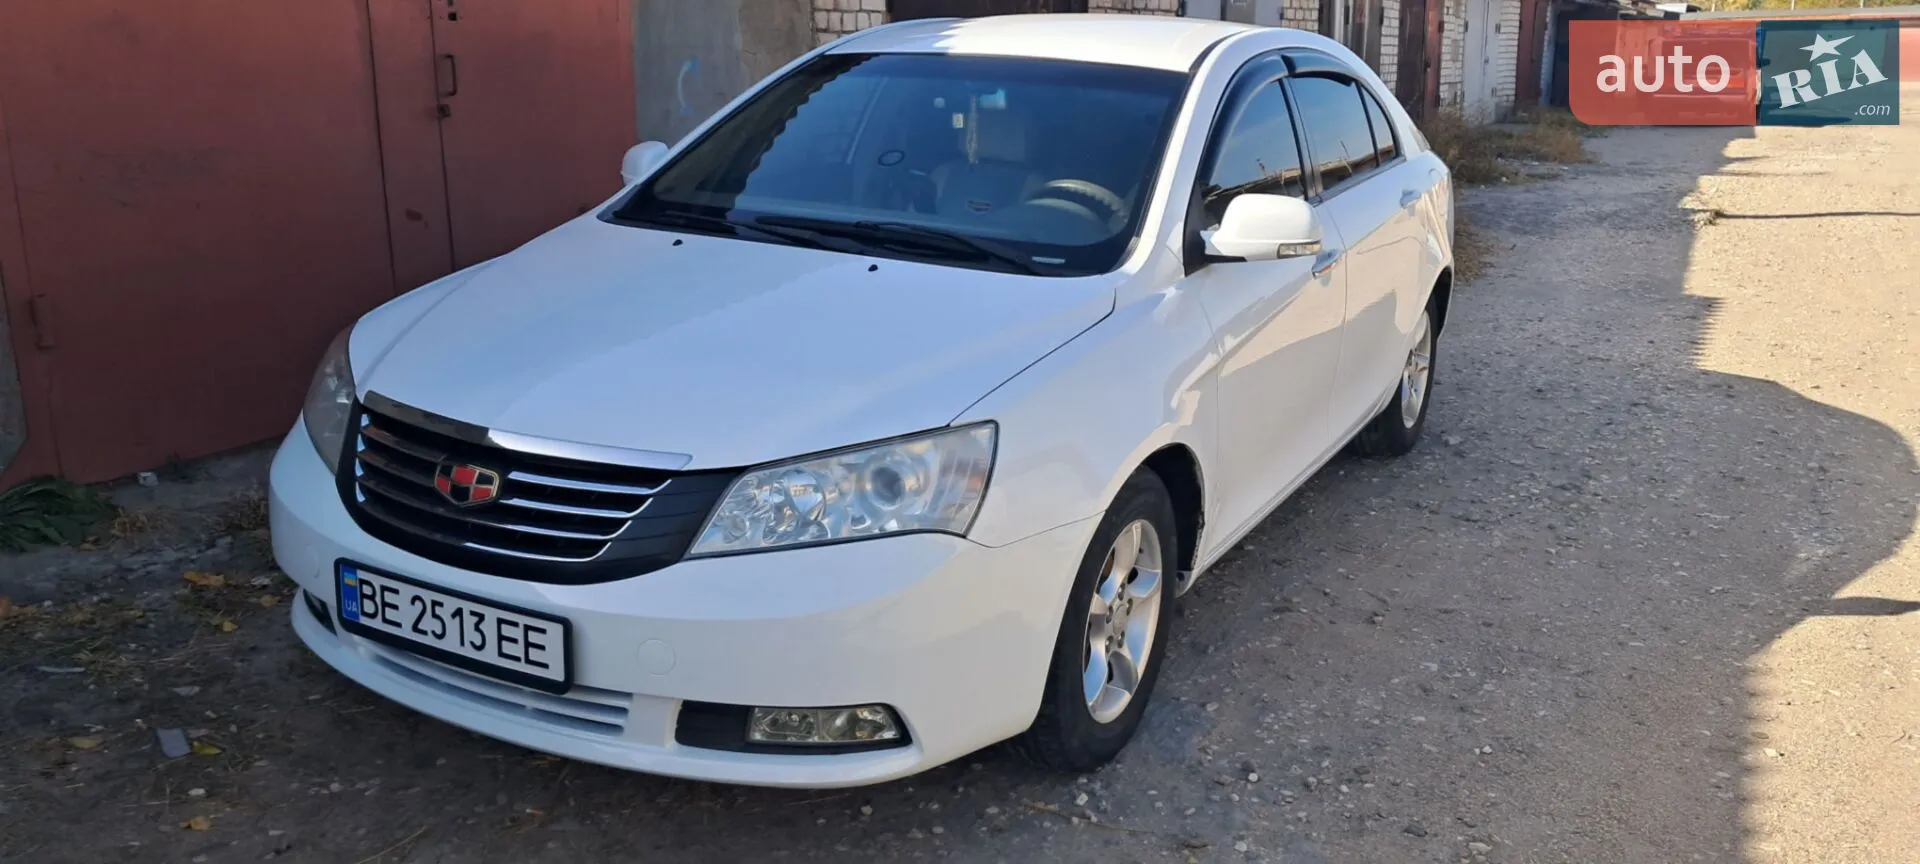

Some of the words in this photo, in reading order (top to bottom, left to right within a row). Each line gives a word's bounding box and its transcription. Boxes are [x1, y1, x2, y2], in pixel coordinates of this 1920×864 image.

[344, 600, 358, 613] UA
[358, 578, 402, 629] BE
[410, 595, 487, 651] 2513
[496, 617, 549, 669] EE
